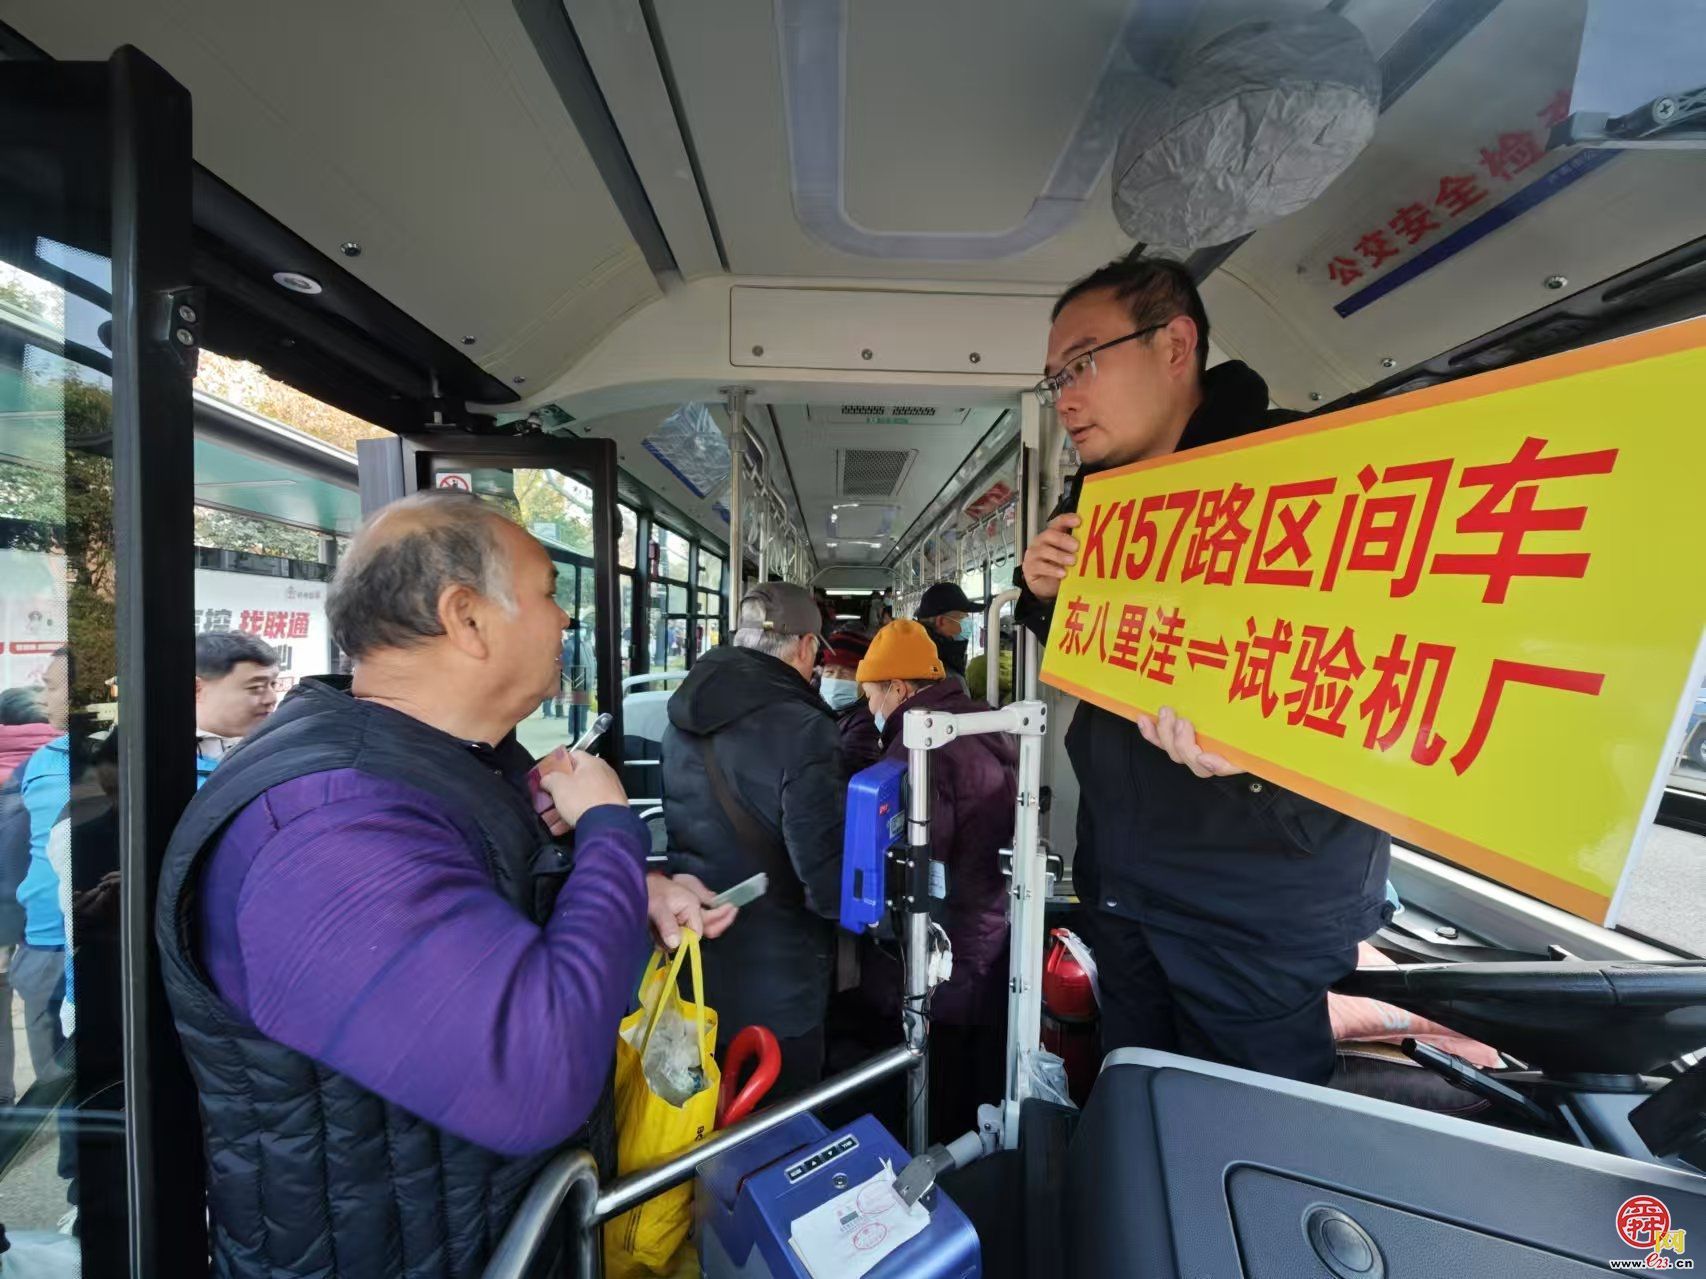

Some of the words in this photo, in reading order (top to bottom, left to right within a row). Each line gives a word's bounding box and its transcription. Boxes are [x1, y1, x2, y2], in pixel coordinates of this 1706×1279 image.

[1078, 436, 1619, 605] K157路区间车
[238, 609, 310, 639] 找联通
[1058, 595, 1187, 686] 东八里洼
[1228, 615, 1606, 777] 试验机厂
